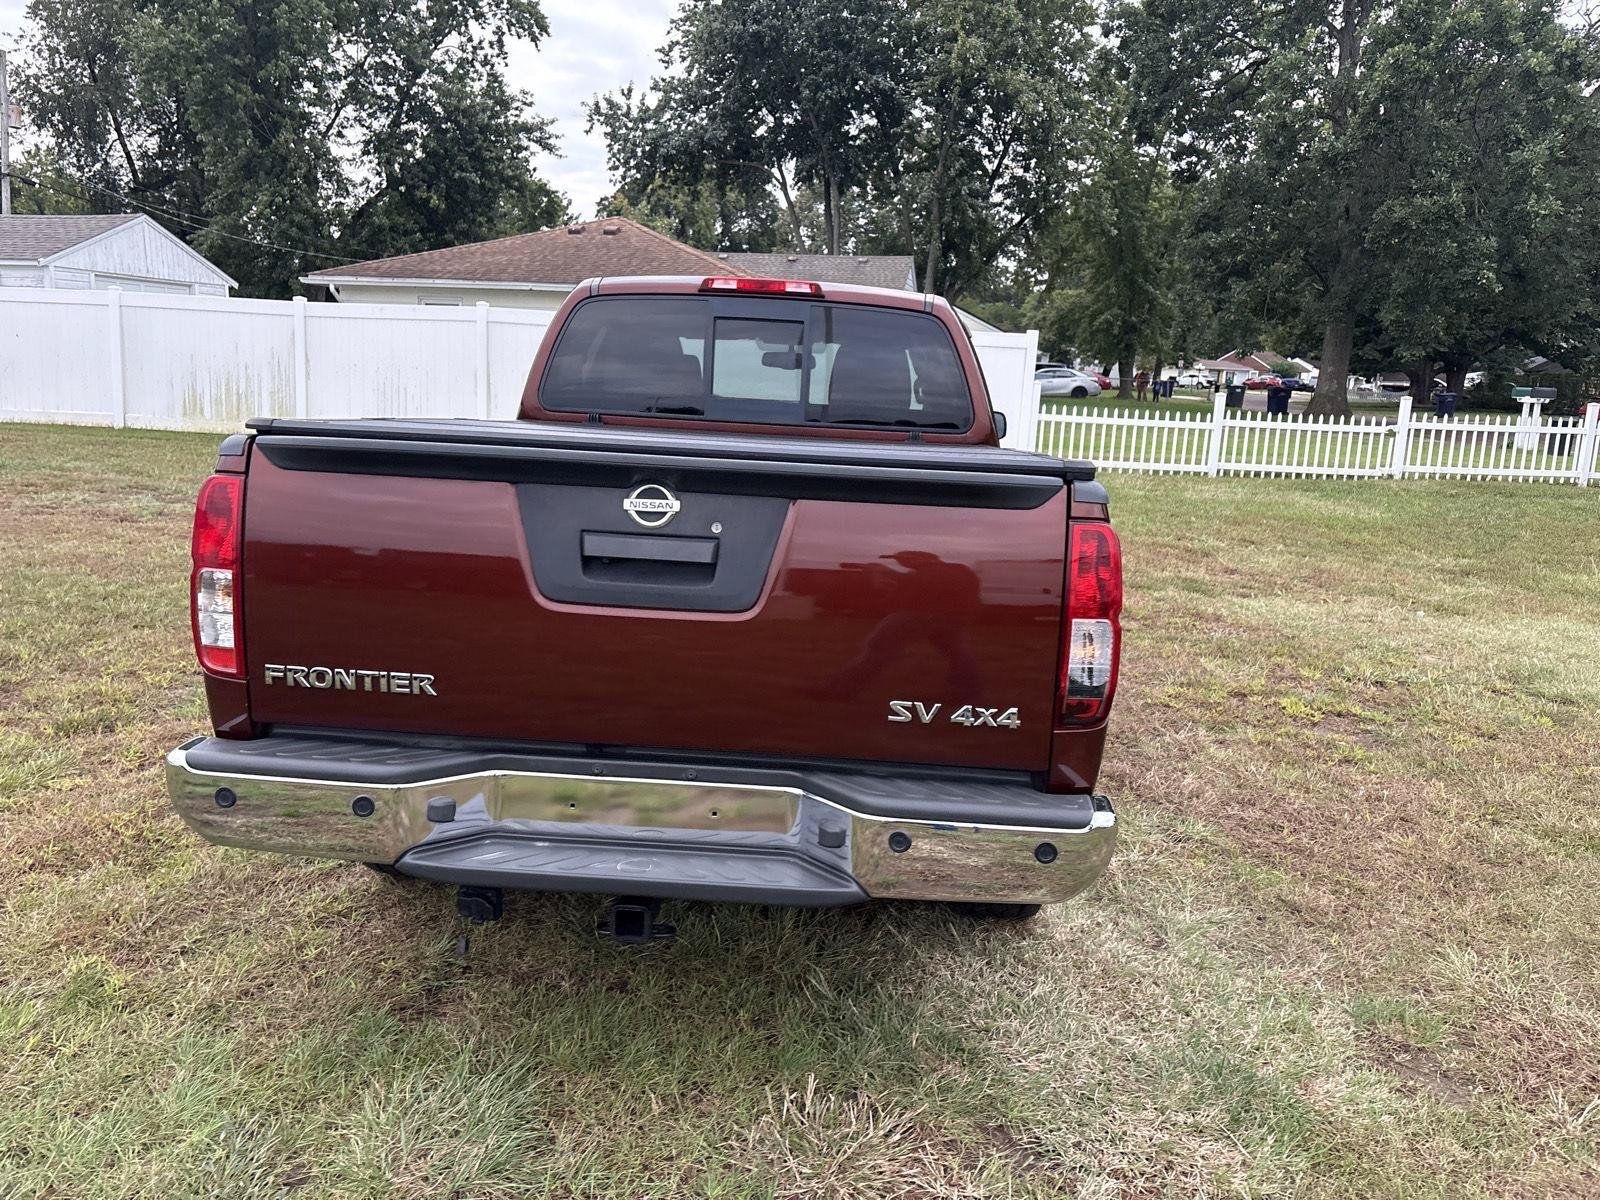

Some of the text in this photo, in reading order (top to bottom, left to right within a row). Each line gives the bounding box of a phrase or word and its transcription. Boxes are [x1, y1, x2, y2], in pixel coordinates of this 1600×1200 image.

[629, 501, 674, 510] NISSAN
[264, 663, 437, 696] FRONTIER
[887, 700, 942, 724] SV
